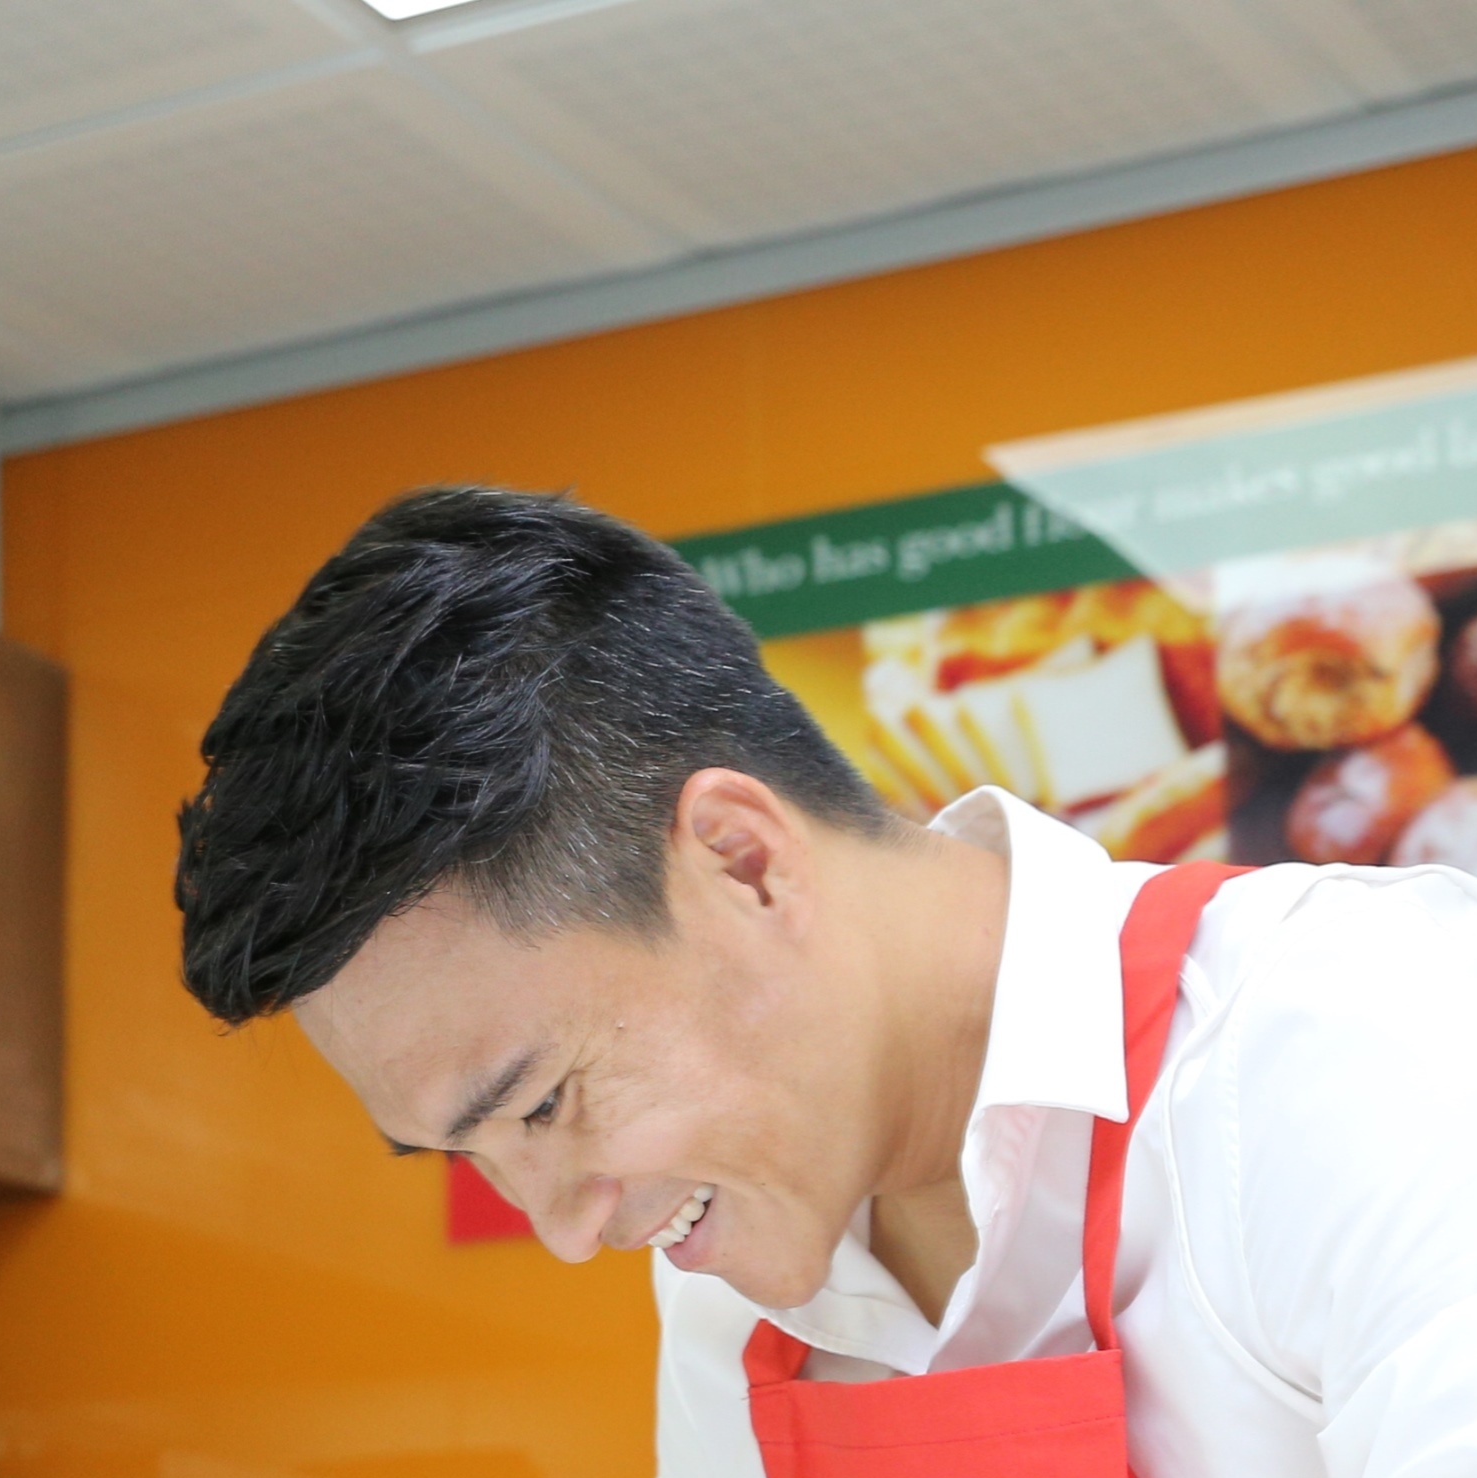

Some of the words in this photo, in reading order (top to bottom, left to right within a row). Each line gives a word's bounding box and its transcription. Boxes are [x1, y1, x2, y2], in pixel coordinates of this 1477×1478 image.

[810, 534, 889, 585] has
[896, 500, 1012, 583] good
[1310, 422, 1437, 502] good
